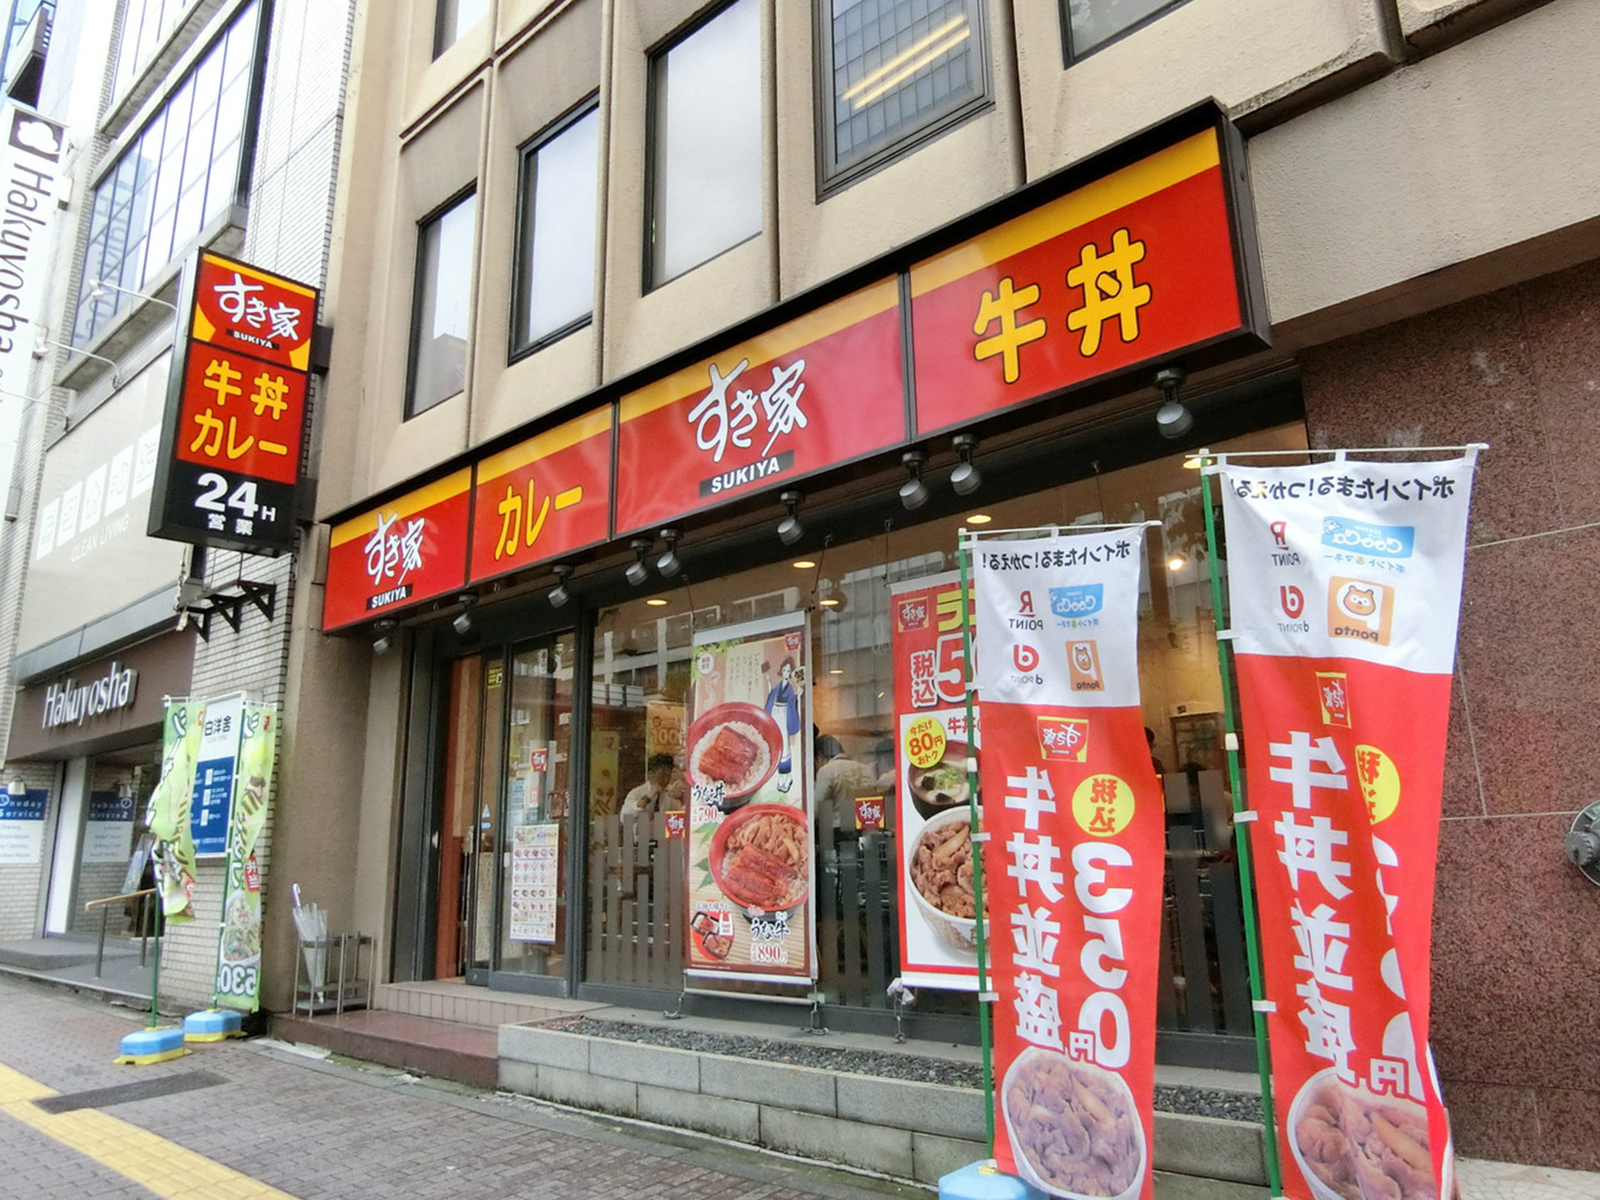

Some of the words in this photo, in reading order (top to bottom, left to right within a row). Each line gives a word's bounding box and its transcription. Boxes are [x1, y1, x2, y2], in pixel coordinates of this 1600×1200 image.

[213, 273, 300, 340] すき家
[973, 227, 1152, 384] 牛丼
[233, 330, 273, 349] SUKIYA
[203, 359, 289, 421] 牛丼
[687, 358, 808, 463] すき家
[190, 408, 288, 460] カレー
[710, 456, 780, 494] SUKIYA
[208, 513, 254, 536] 営業
[494, 479, 583, 561] カレー
[364, 511, 425, 586] すき家
[371, 587, 407, 609] SUKIYA
[912, 653, 935, 705] 税込
[938, 633, 979, 701] 5
[42, 661, 135, 729] Hakuyosha
[909, 720, 932, 736] 今だけ
[909, 732, 943, 757] 80円
[917, 750, 938, 765] おトク
